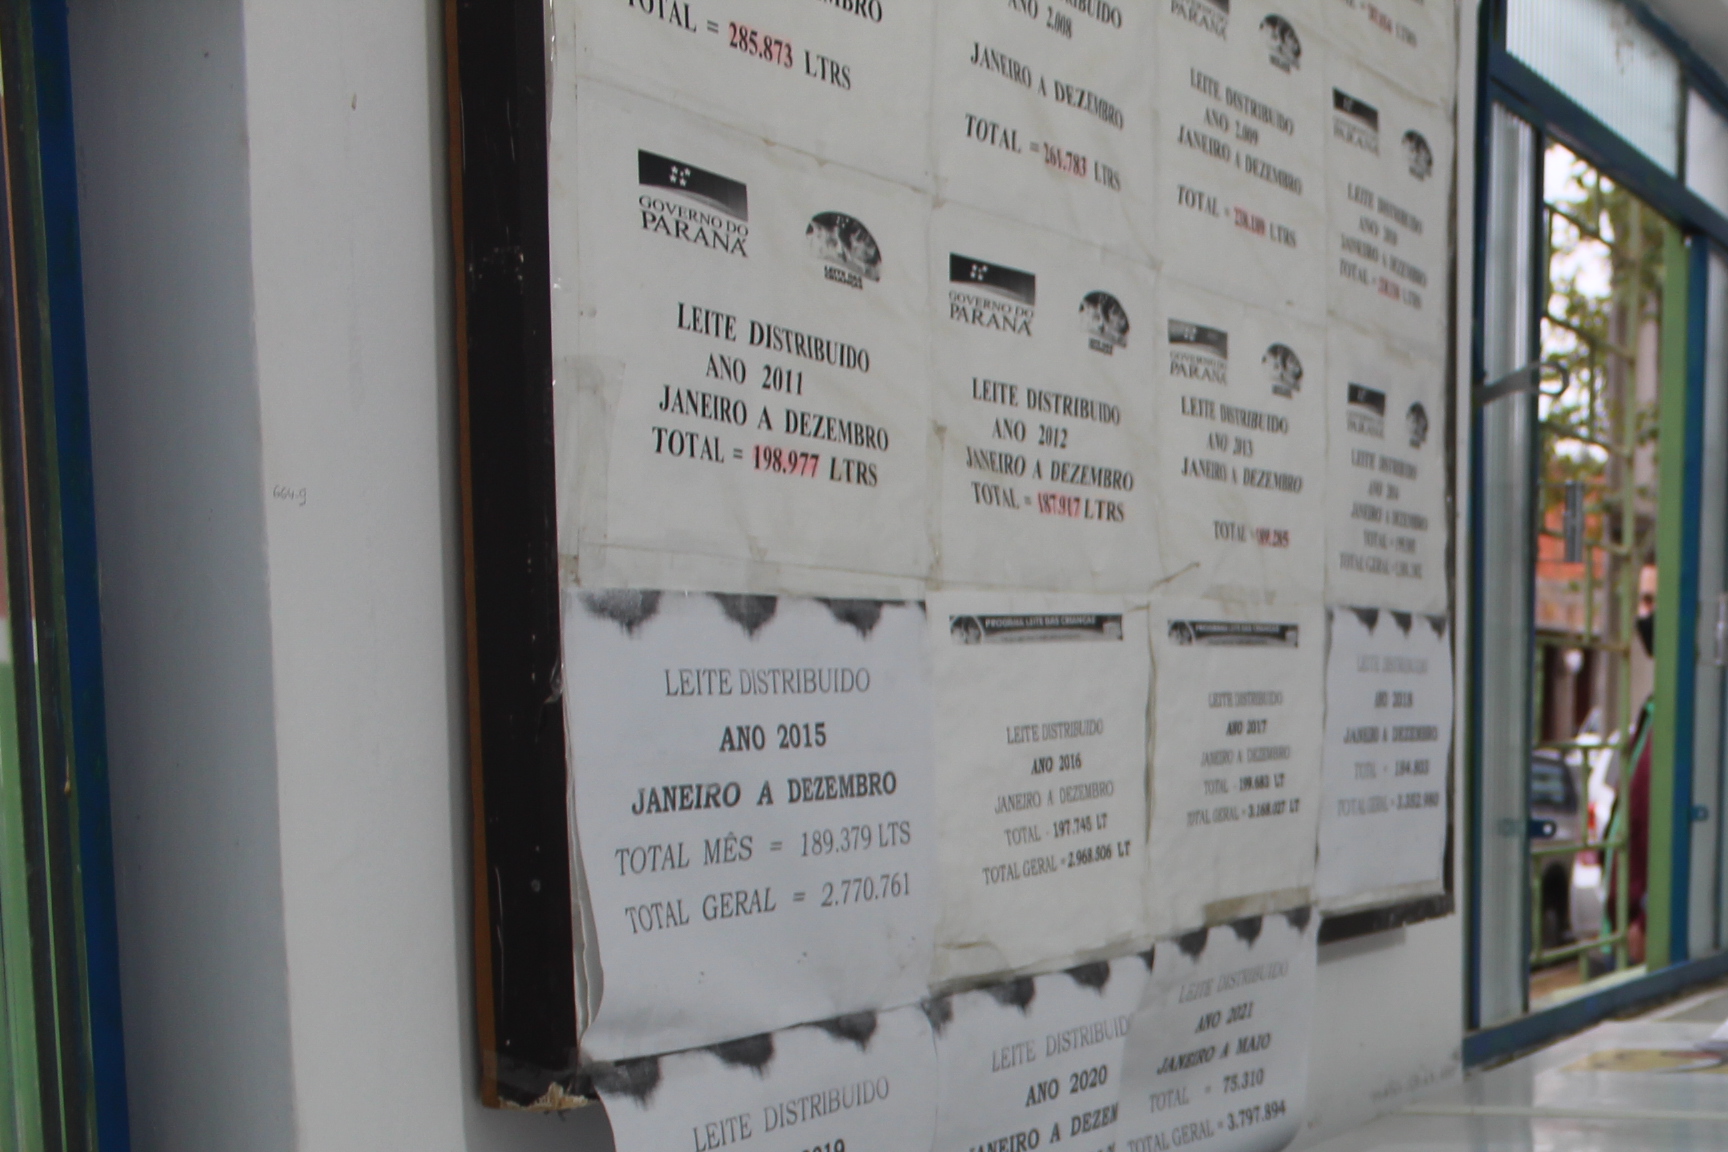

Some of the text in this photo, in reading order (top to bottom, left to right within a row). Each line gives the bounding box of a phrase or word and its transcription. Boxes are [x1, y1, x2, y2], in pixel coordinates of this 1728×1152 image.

[1046, 6, 1072, 39] 2.008
[728, 21, 793, 69] 285.873
[804, 51, 851, 90] LTRS
[970, 41, 1124, 130] JANEIRO A DEZEMBRO
[1190, 67, 1295, 136] LEITE DISTRIBUIDO
[1204, 107, 1229, 133] ANO
[965, 113, 1121, 192] TOTAL 261.783 LTRS
[1177, 124, 1231, 162] JANEIRO
[1245, 153, 1303, 196] DEZEMBRO
[638, 194, 749, 237] GOVERNO DO
[640, 207, 748, 258] PARANÁ
[1177, 184, 1297, 248] TOTAL LTRS
[949, 290, 1034, 319] GOVERNO DO
[949, 302, 1033, 337] PARANÁ
[677, 301, 870, 373] LEITE DISTRIBUIDO
[705, 352, 803, 396] ANO 2011
[659, 384, 889, 452] JANEIRO A DEZEMBRO
[972, 377, 1121, 426] LEITE DISTRIBUIDO
[1181, 395, 1289, 434] LEITE DISTRIBUIDO
[992, 417, 1068, 449] ANO 2012
[1207, 431, 1228, 452] ANO
[652, 426, 724, 464] TOTAL
[753, 444, 819, 478] 198.977
[829, 456, 878, 487] LTRS
[966, 446, 1135, 492] JANEIRO A DEZEMBRO
[1181, 456, 1227, 482] JANEIRO
[1243, 466, 1303, 494] DEZEMBRO
[971, 481, 1019, 510] TOTAL
[1084, 498, 1125, 522] LTRS
[1213, 520, 1247, 543] TOTAL
[664, 667, 871, 698] LEITE DISTRIBUIDO
[718, 721, 826, 752] ANO 2015
[1006, 719, 1104, 745] LEITE DISTRIBUIDO
[1031, 752, 1082, 776] ANO 2016
[631, 770, 897, 816] JANEIRO A DEZEMBRO
[994, 791, 1041, 815] JANEIRO
[1059, 780, 1115, 805] DEZEMBRO
[615, 842, 690, 876] TOTAL
[703, 831, 753, 866] MÊS
[800, 824, 872, 857] 189.379
[878, 820, 911, 848] LTS
[1004, 825, 1041, 847] TOTAL
[1096, 813, 1108, 830] LT
[982, 862, 1020, 886] TOTAL
[1022, 854, 1058, 877] GERAL
[625, 898, 690, 935] TOTAL
[702, 886, 777, 922] GERAL
[821, 871, 911, 908] 2.770.761
[1179, 961, 1289, 1004] LEITE DISTRIBUIDO
[1195, 1001, 1254, 1034] ANO 2021
[991, 1039, 1036, 1073] LEITE
[1157, 1032, 1272, 1075] JANEIRO A MAIO
[764, 1076, 889, 1133] DISTRIBUIDO
[1025, 1063, 1108, 1107] ANO 2020
[1149, 1068, 1265, 1114] TOTAL 75.310
[1050, 1122, 1061, 1144] A
[1172, 1120, 1214, 1146] GERAL
[1227, 1100, 1287, 1132] 3.797.894
